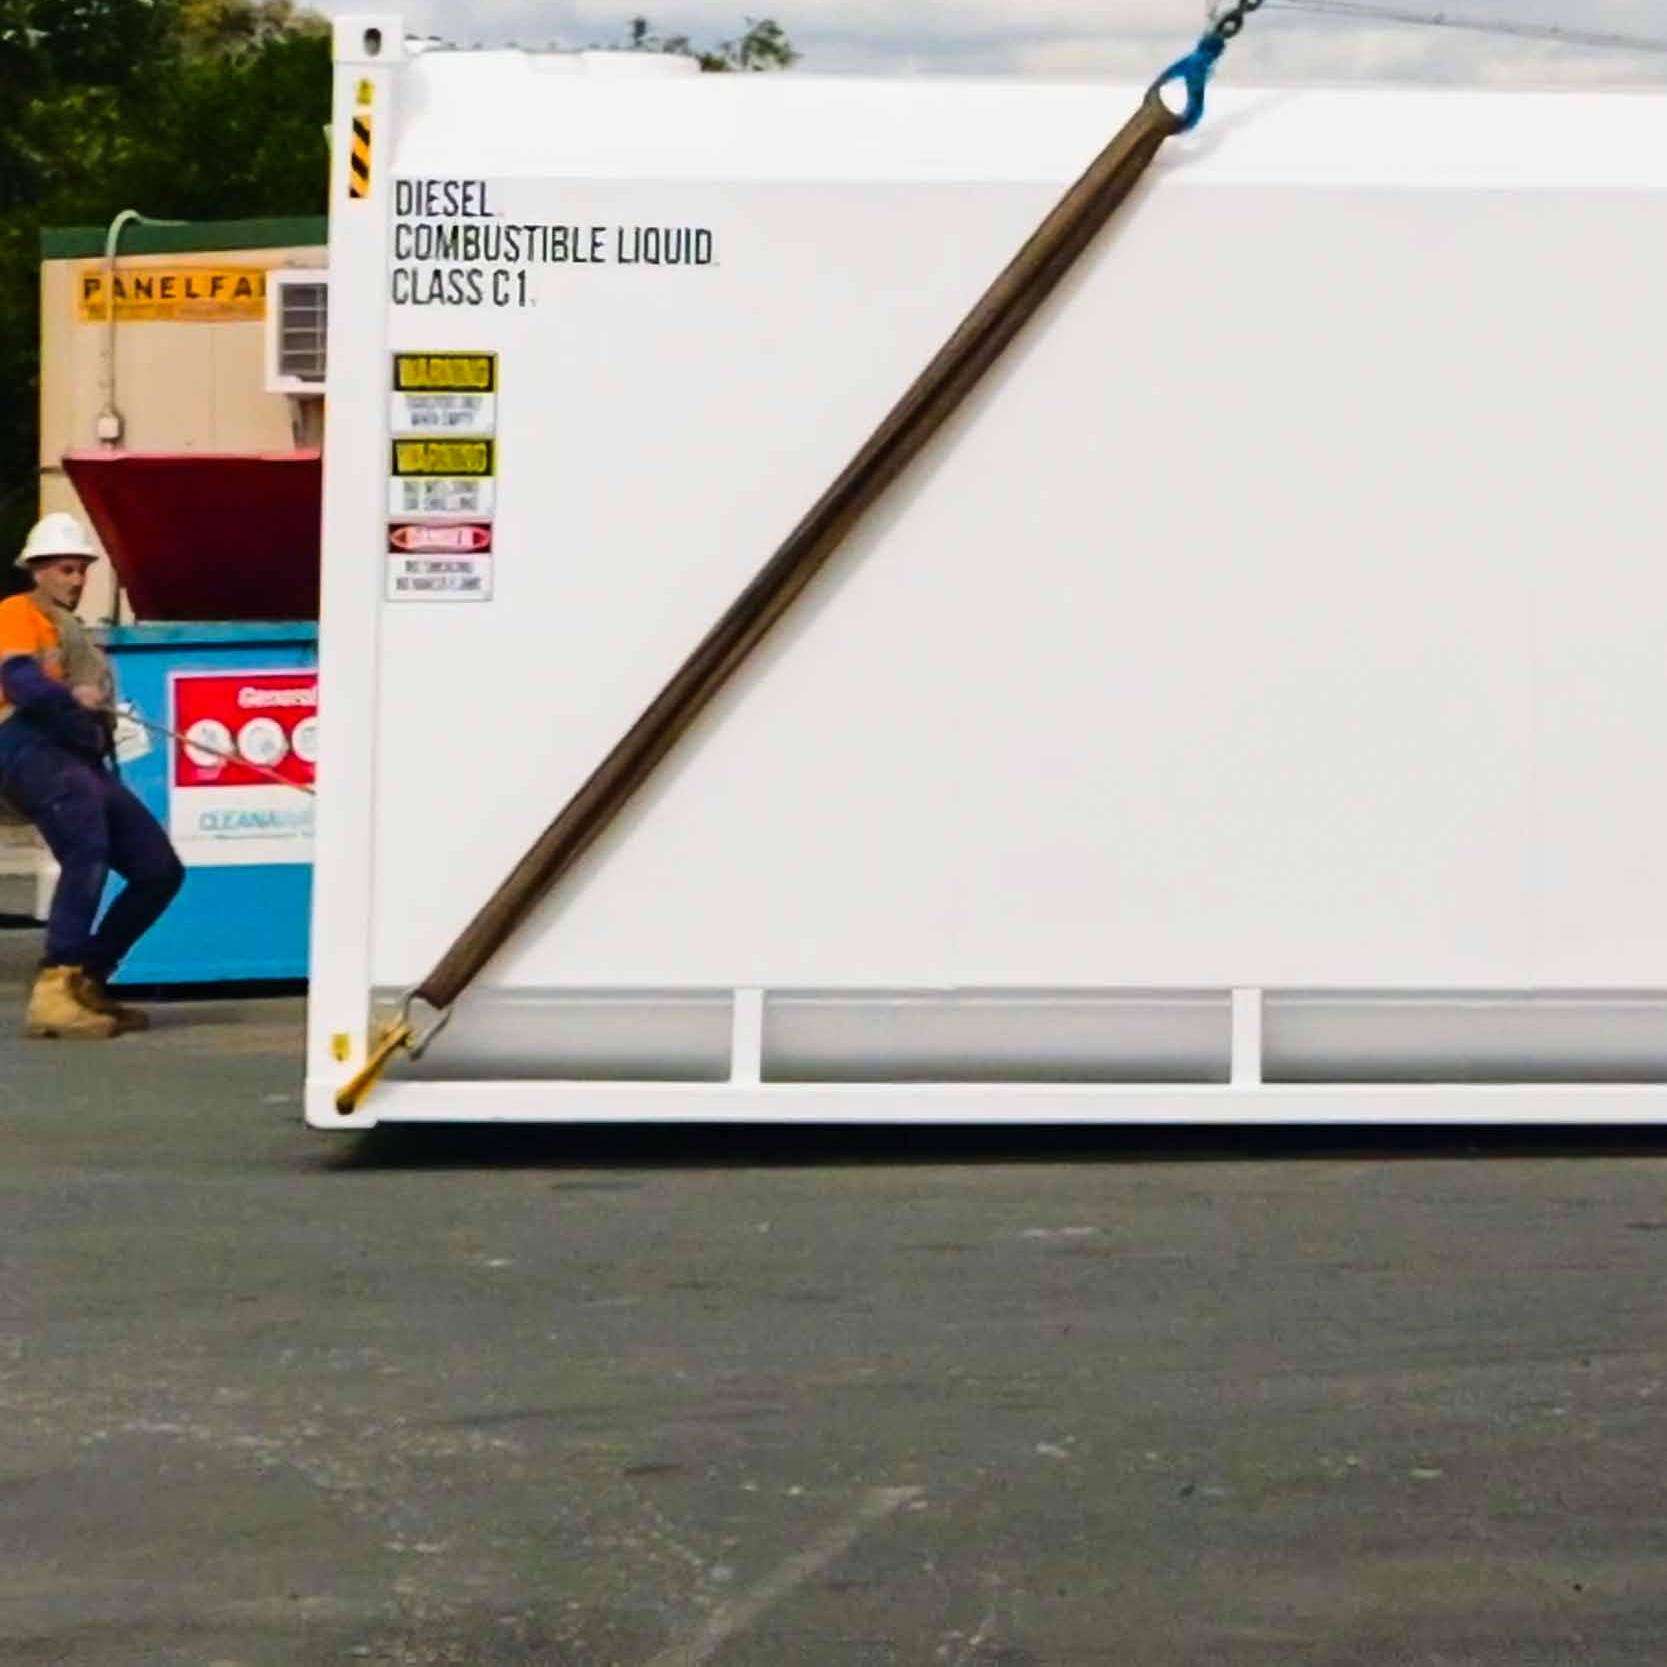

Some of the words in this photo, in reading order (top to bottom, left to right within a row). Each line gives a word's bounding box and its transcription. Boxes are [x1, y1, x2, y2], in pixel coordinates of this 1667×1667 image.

[396, 180, 493, 217] DIESEL
[396, 224, 606, 263] COMBUSTIBLE
[618, 227, 711, 264] LIQUID
[393, 268, 482, 305] CLASS
